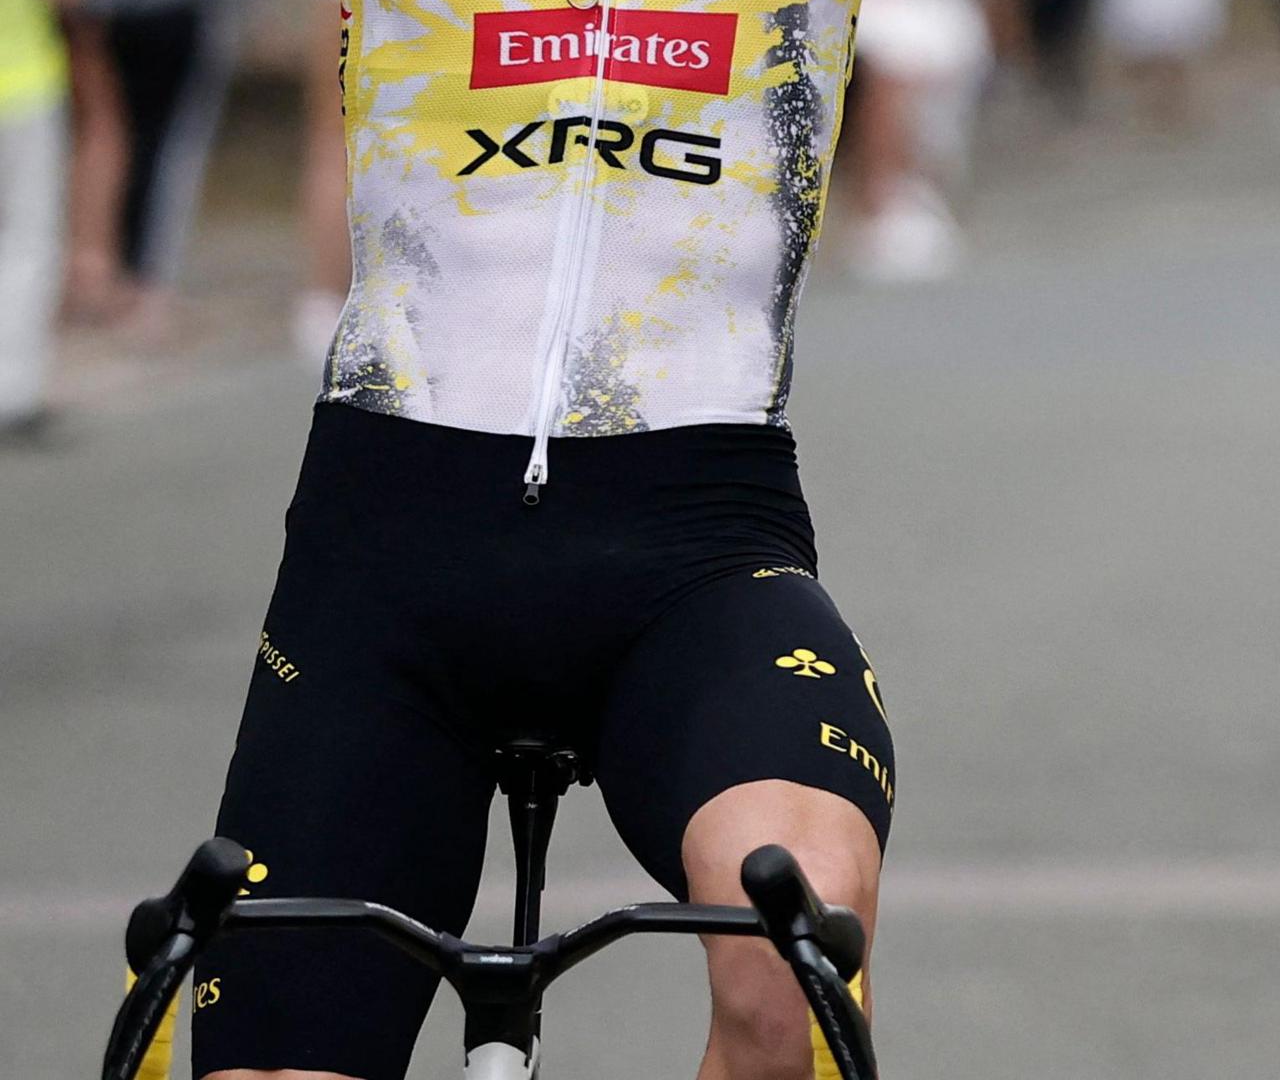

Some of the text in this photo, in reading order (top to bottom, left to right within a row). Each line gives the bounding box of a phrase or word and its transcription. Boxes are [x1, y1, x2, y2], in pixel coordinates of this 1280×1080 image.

[497, 22, 712, 70] Emirates
[456, 116, 723, 186] XRG
[818, 721, 895, 806] Emir
